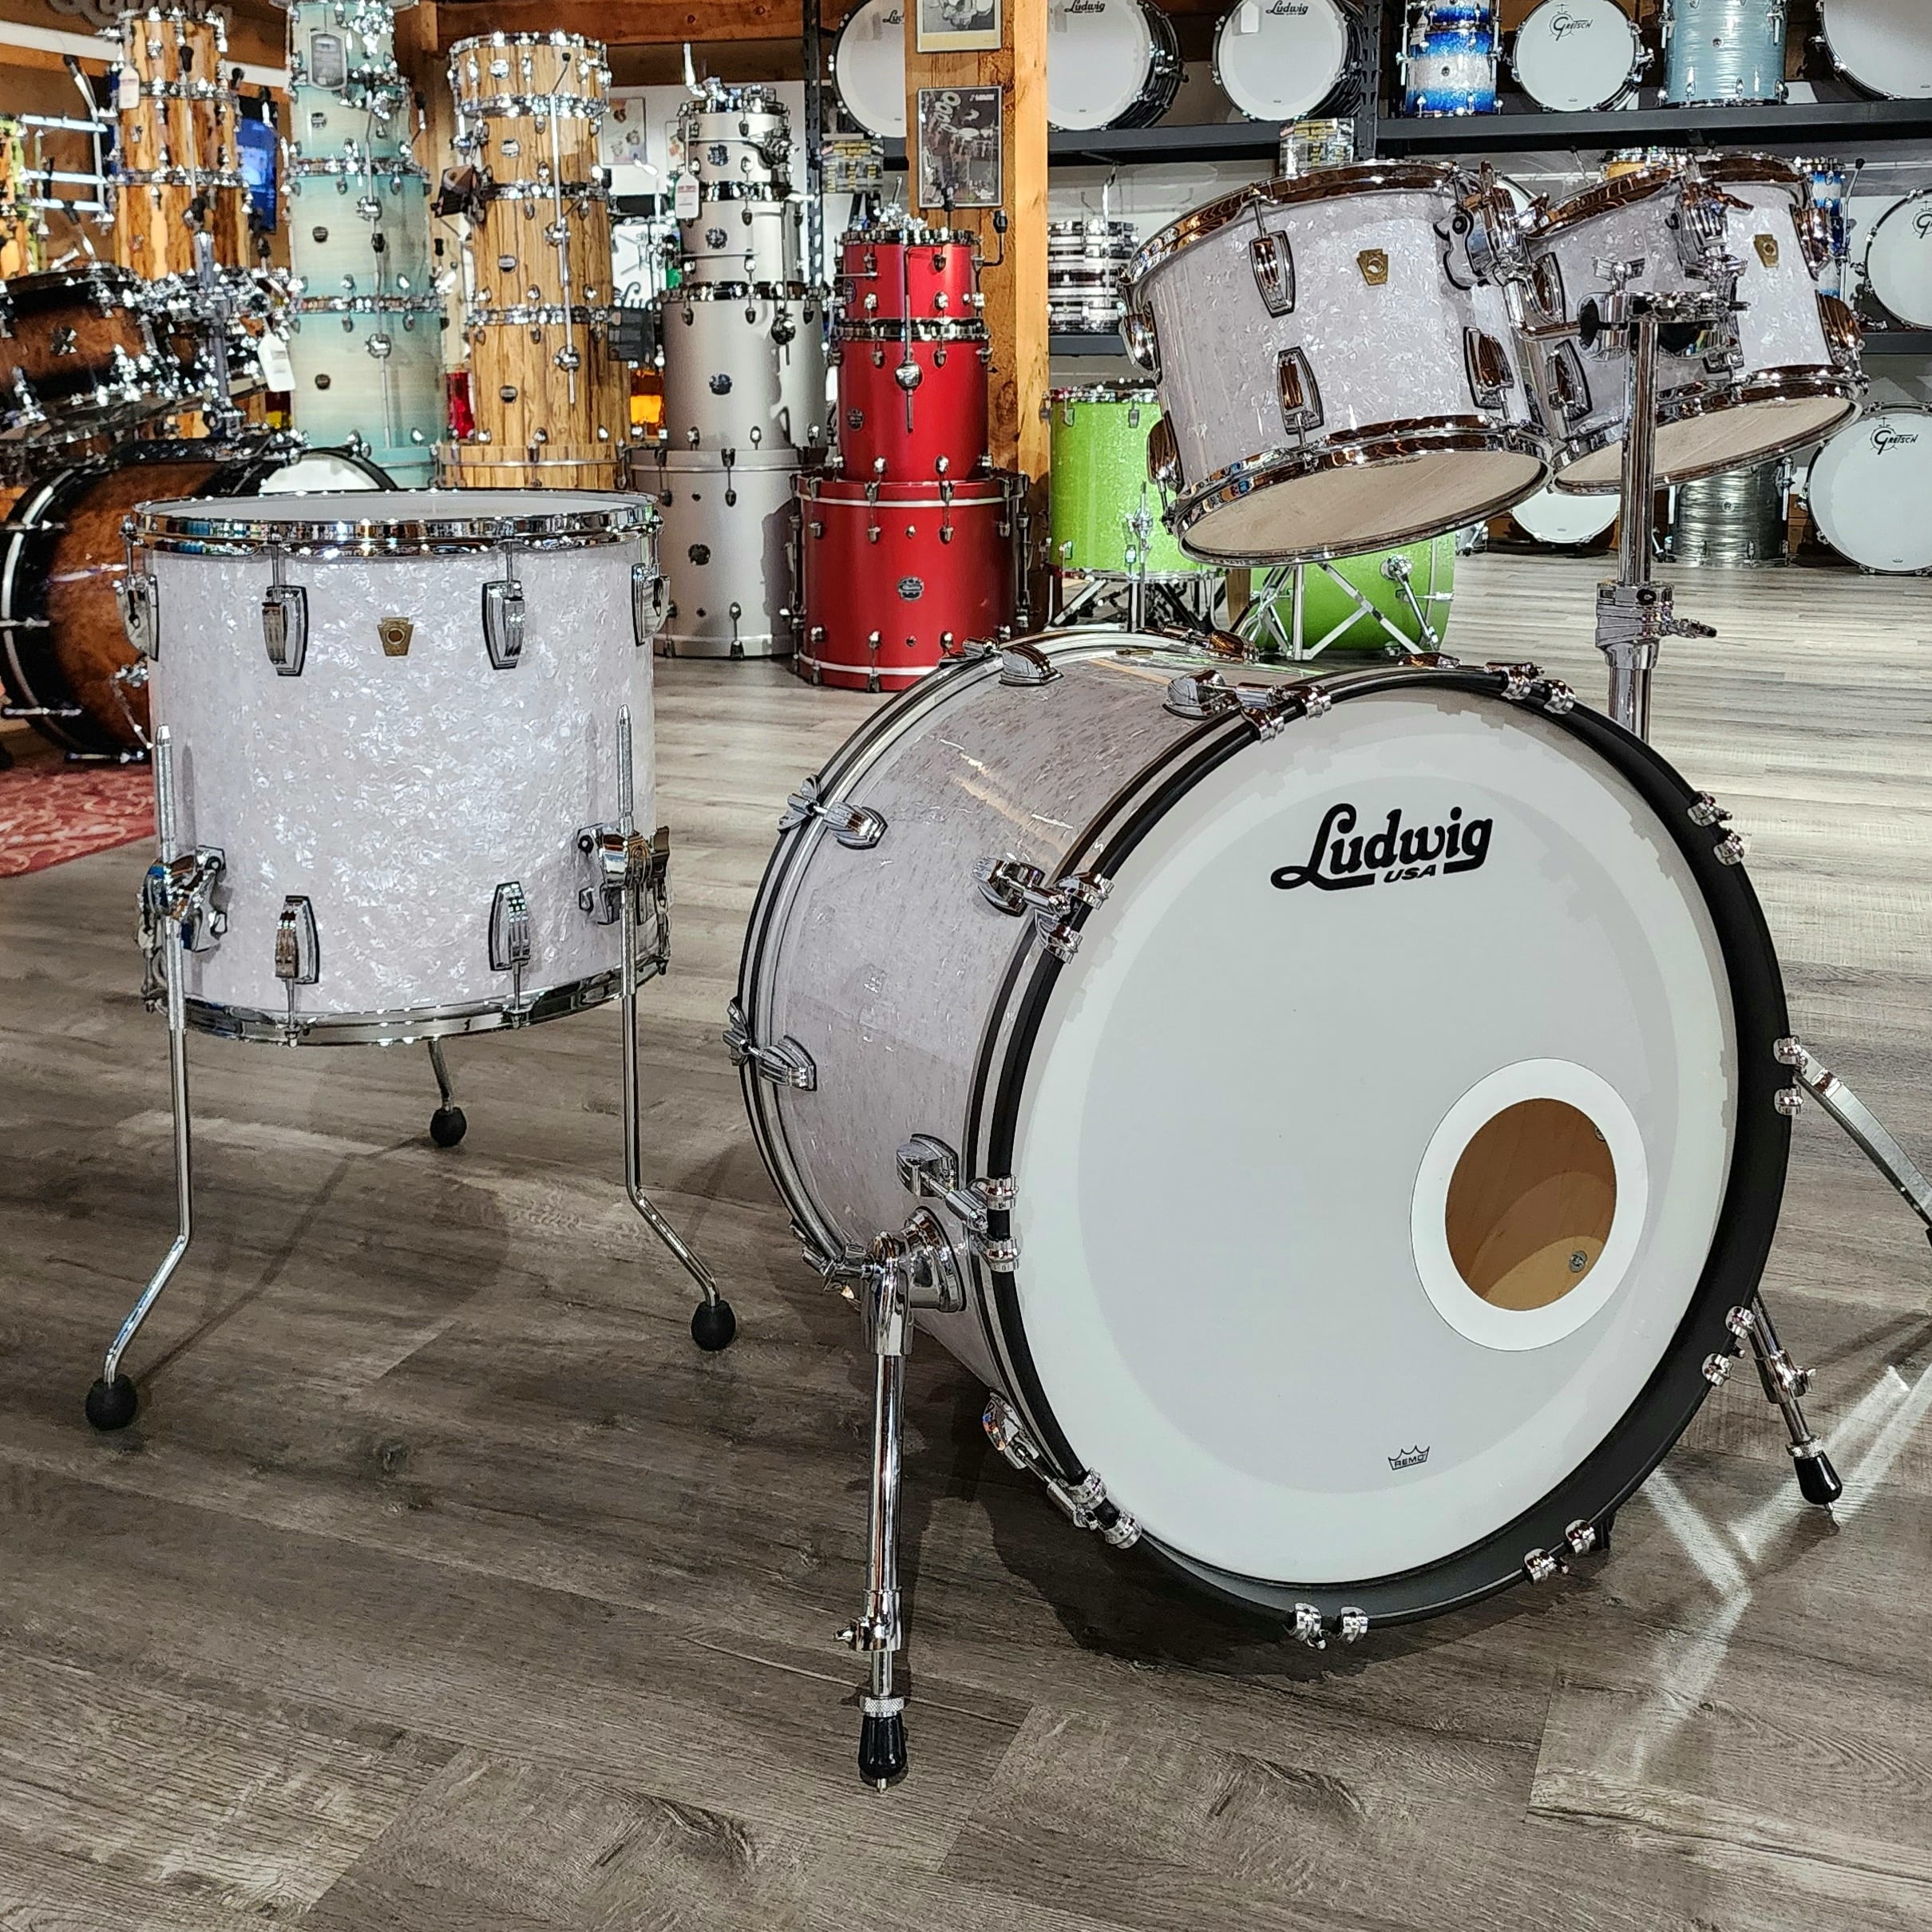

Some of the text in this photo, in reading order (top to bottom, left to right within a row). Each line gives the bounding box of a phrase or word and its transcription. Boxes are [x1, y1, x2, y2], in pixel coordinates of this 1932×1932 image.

[1063, 0, 1106, 14] Ludwig
[1265, 0, 1308, 15] Ludwig
[1270, 802, 1493, 891] Ludwig
[1384, 864, 1437, 883] USA
[1394, 1454, 1426, 1468] REMO
